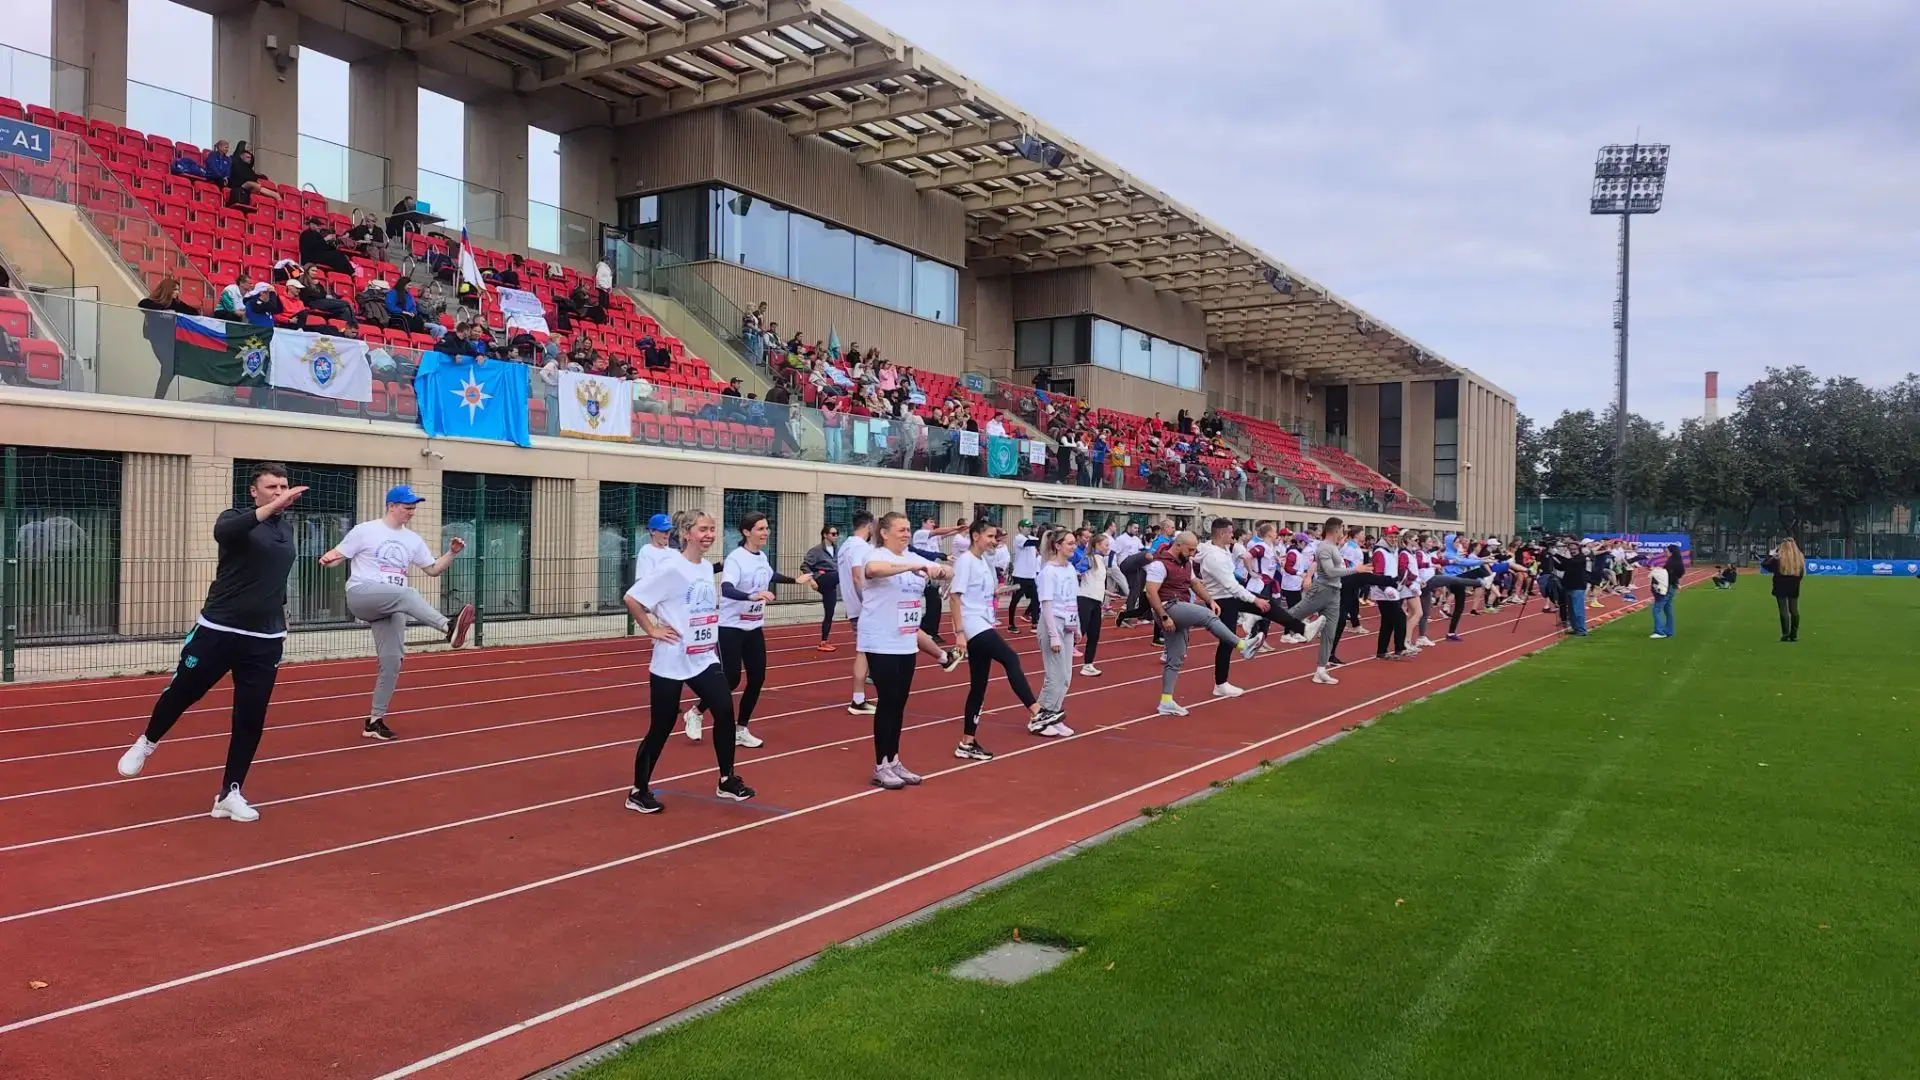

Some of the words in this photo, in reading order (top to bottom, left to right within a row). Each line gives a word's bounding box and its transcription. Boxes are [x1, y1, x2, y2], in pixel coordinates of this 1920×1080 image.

[12, 130, 43, 152] A1
[904, 611, 919, 623] 142
[694, 628, 712, 641] 156
